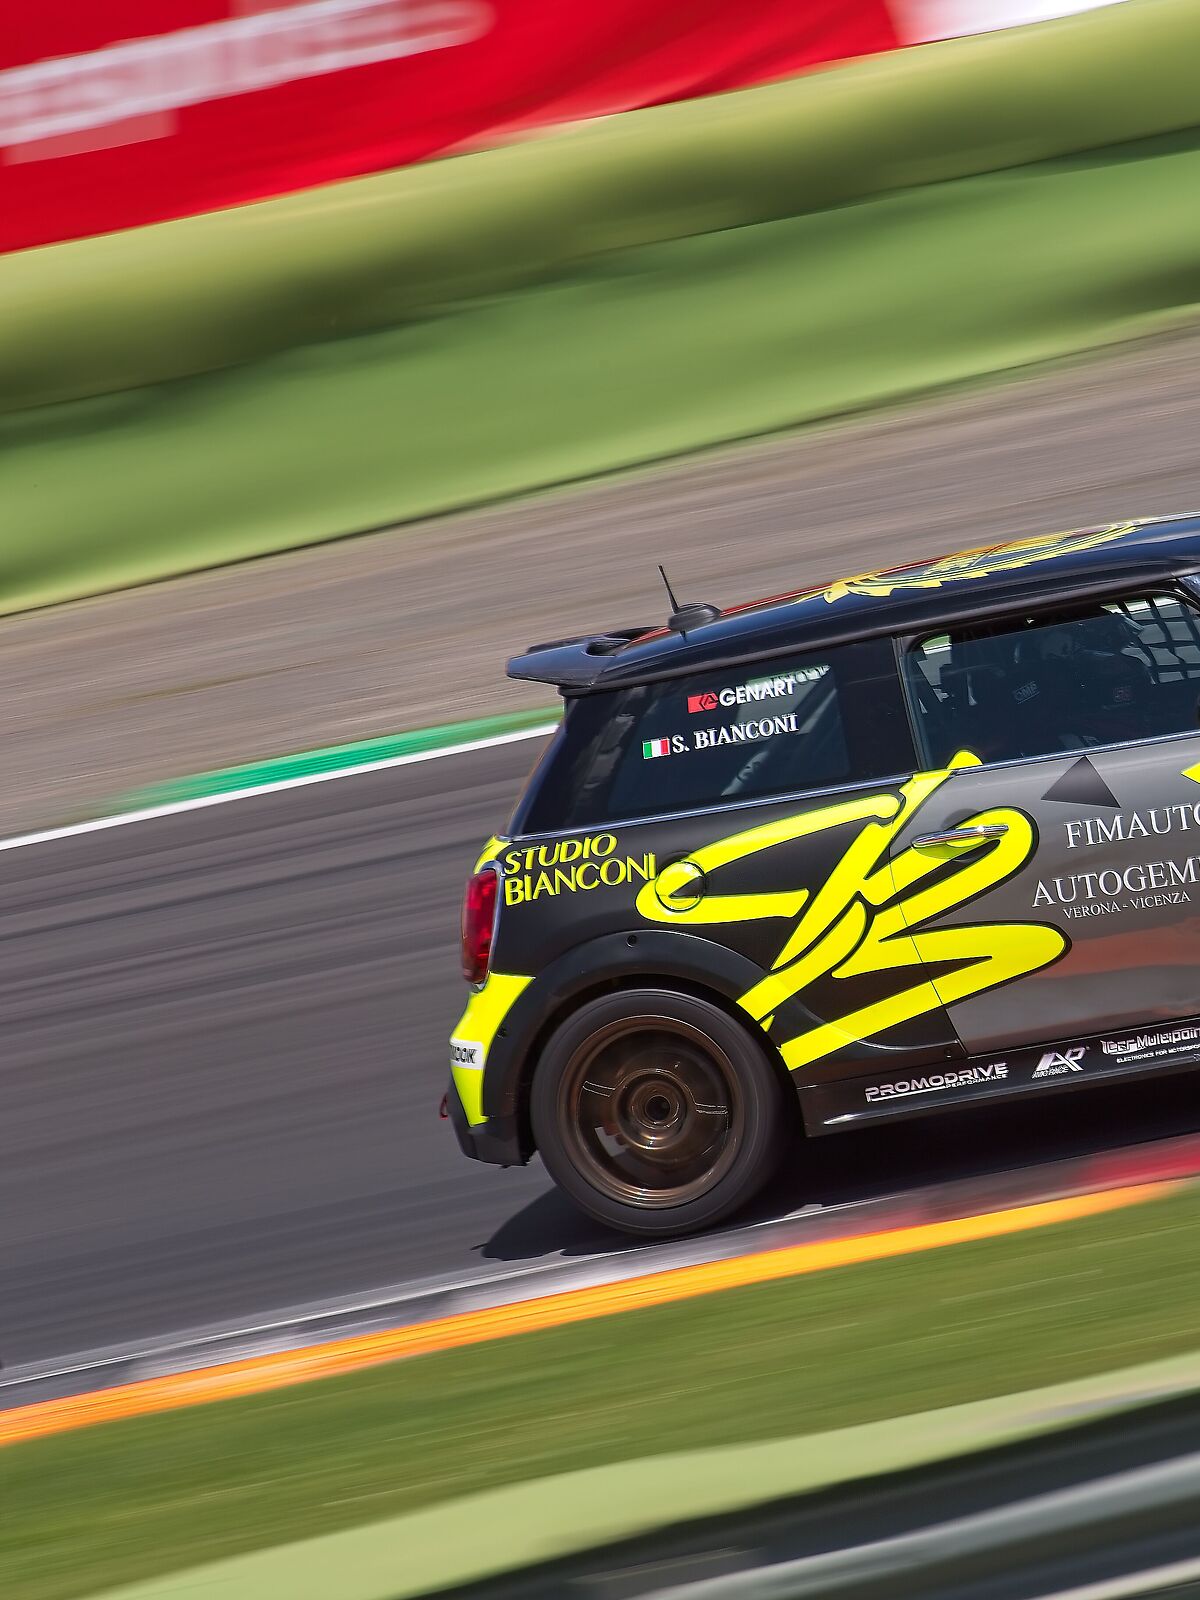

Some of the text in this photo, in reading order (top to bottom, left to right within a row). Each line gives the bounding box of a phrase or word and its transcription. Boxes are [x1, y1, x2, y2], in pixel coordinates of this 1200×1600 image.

[718, 677, 796, 707] GENART
[672, 713, 800, 753] S. BIANCONI
[504, 833, 618, 876] STUDIO
[505, 852, 657, 906] BIANCONI
[1063, 900, 1121, 919] VERONA
[1130, 890, 1192, 910] VICENZA
[1155, 1048, 1168, 1057] FOR
[865, 1062, 1010, 1102] PROMODRIVE
[946, 1073, 1008, 1089] PERFORMANCE
